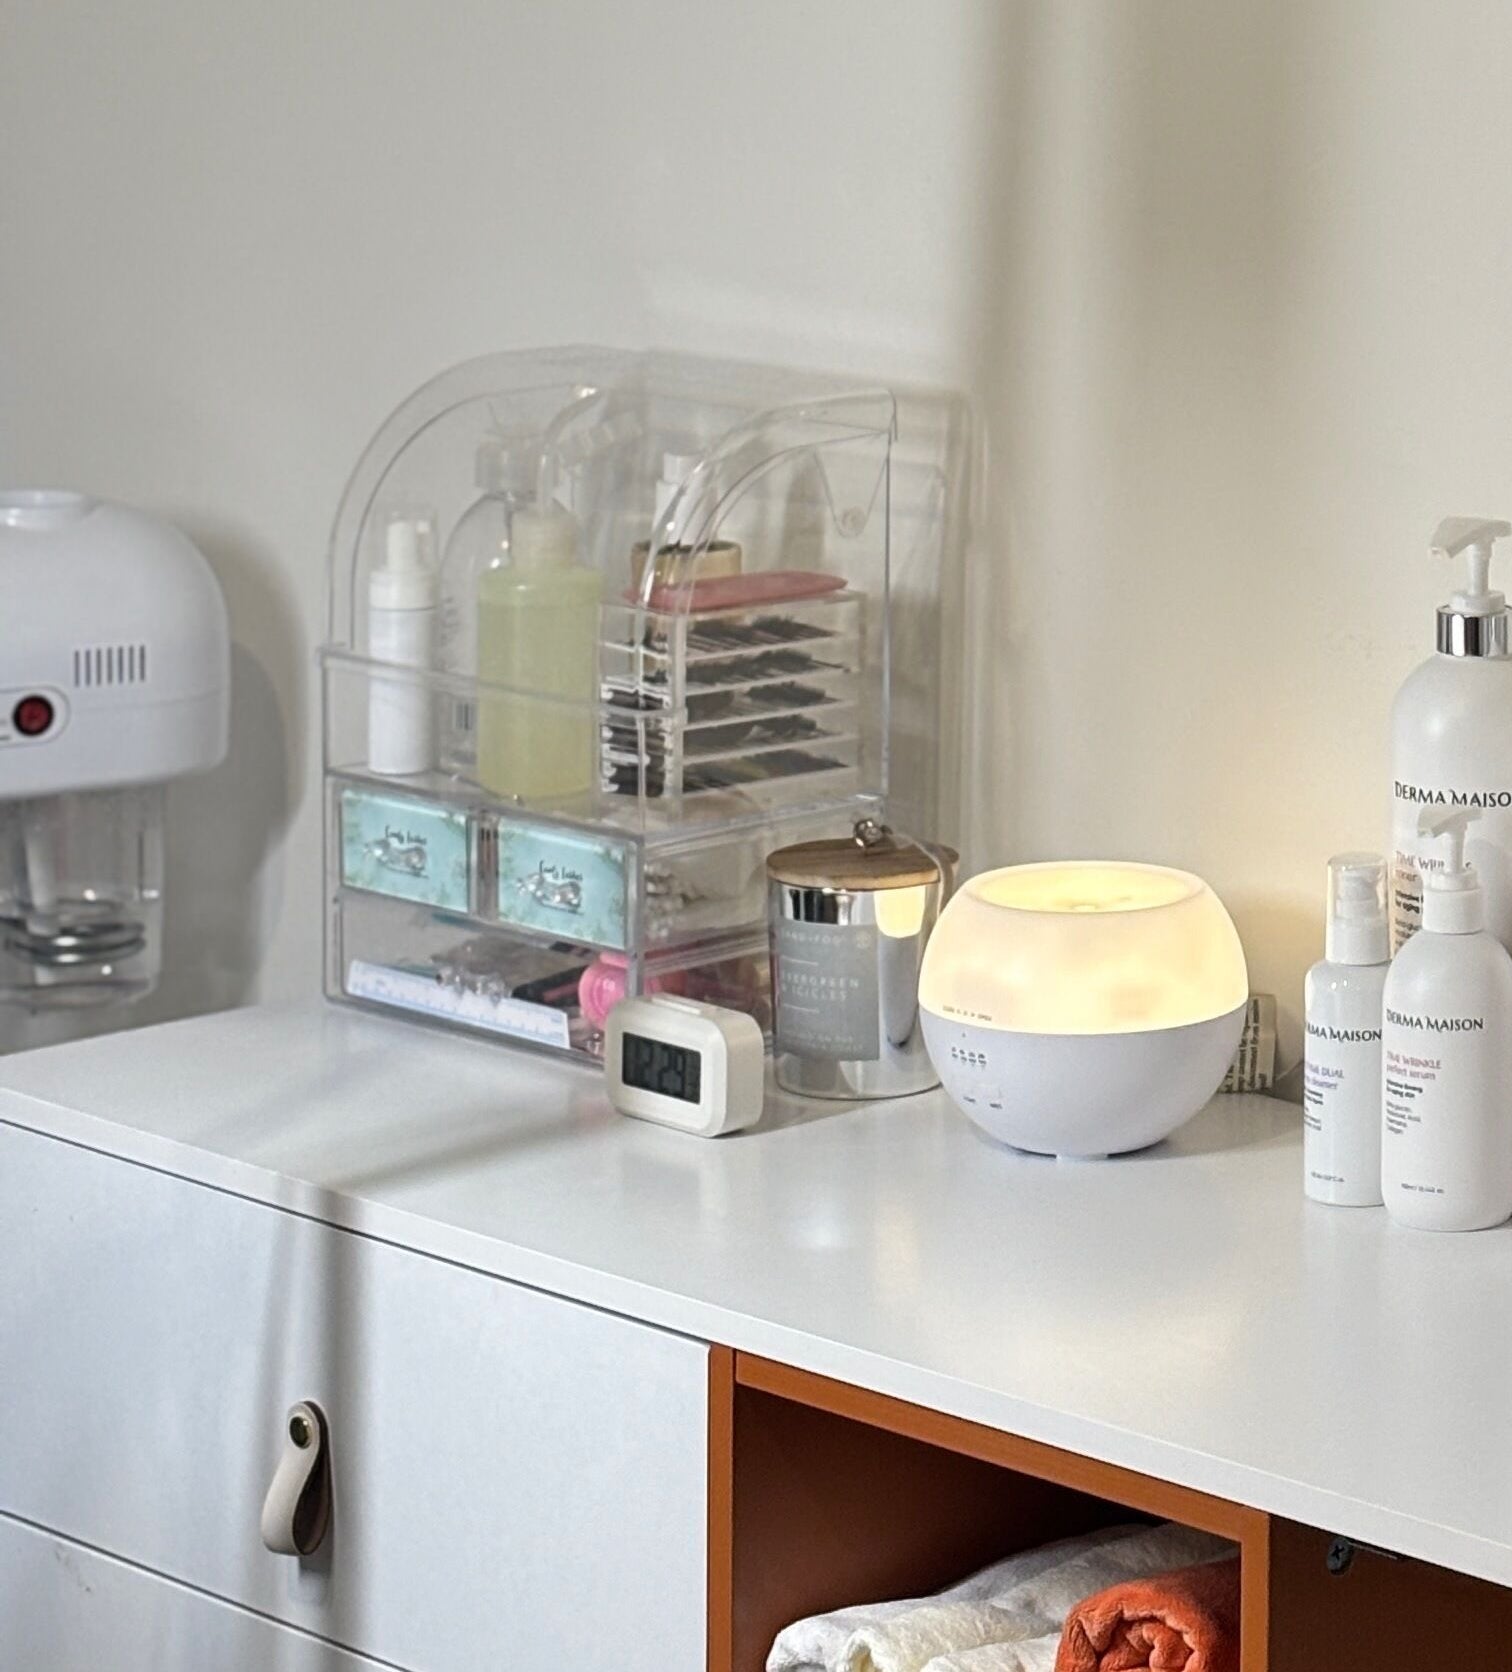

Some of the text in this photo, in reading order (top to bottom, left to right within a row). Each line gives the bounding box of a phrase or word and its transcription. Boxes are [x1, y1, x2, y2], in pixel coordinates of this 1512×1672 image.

[1394, 780, 1446, 805] DERMA
[1386, 1008, 1484, 1033] DERMA MAISON
[1329, 1026, 1382, 1043] MAISON
